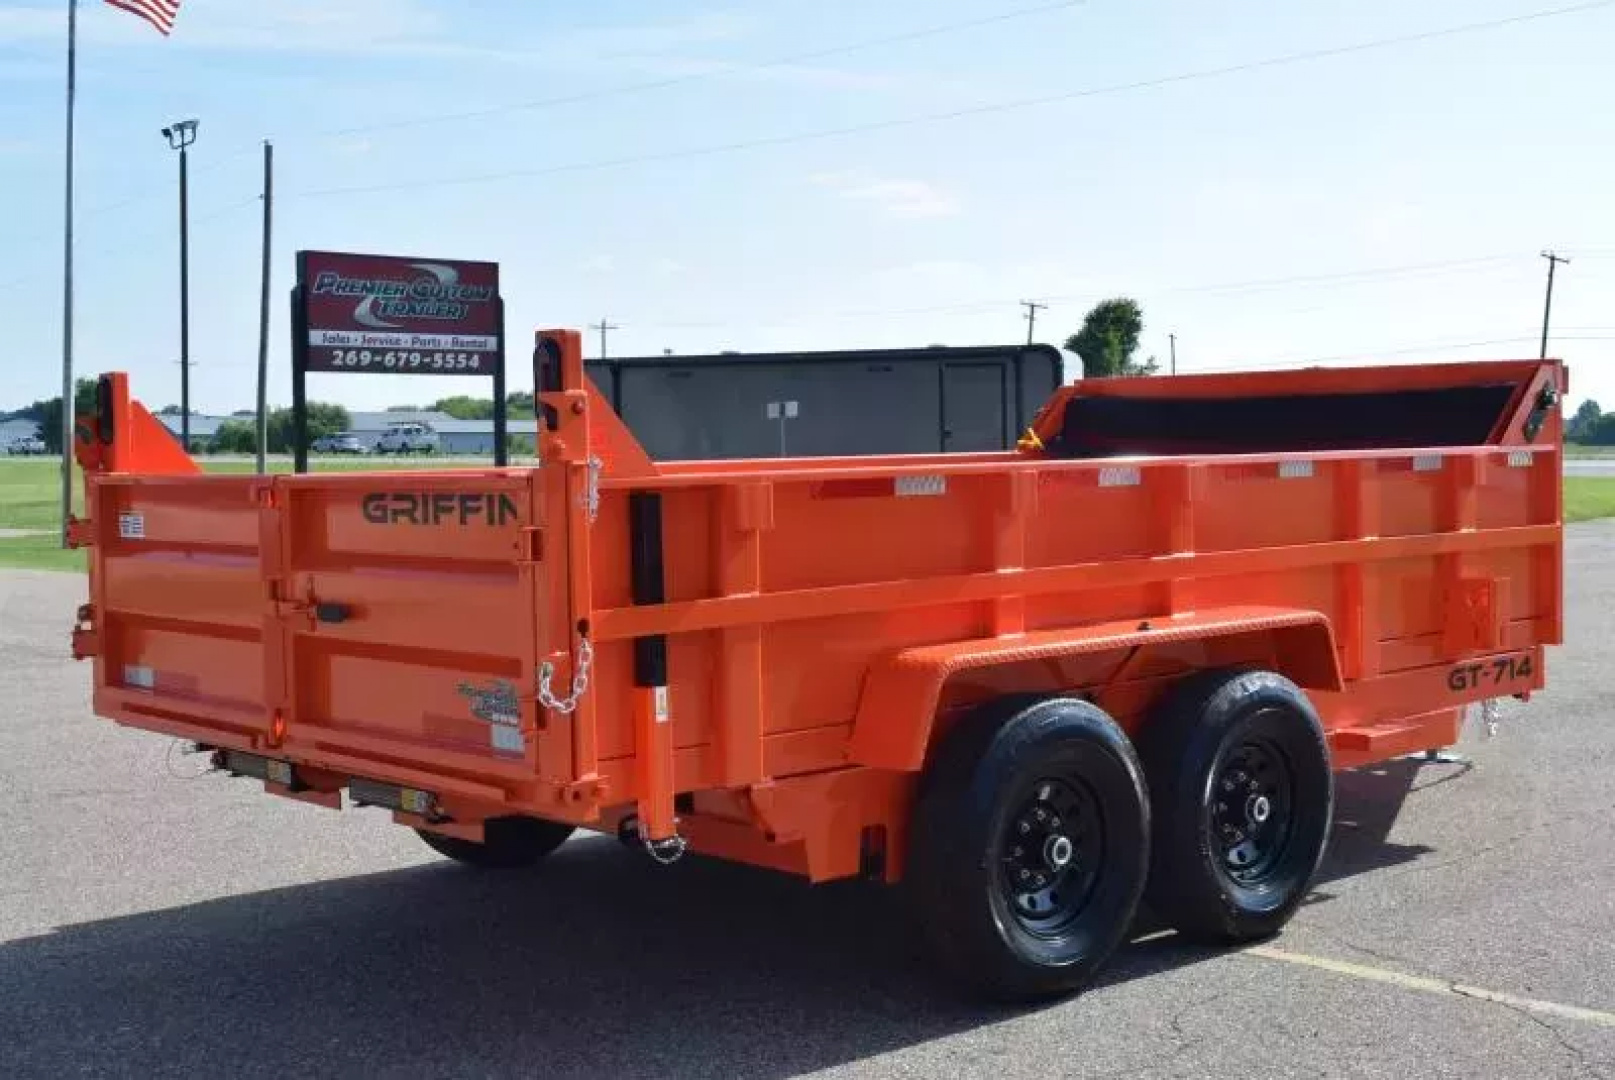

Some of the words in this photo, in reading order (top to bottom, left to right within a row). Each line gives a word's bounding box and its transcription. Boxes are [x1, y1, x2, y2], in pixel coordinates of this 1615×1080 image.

[312, 271, 408, 296] PREMIER
[322, 332, 350, 344] Sales
[361, 334, 401, 346] Service
[411, 336, 441, 348] Parts
[450, 337, 488, 349] Rental
[331, 350, 480, 369] 269-679-5554
[362, 492, 518, 526] GRIFFIN
[1448, 656, 1532, 691] GT-714
